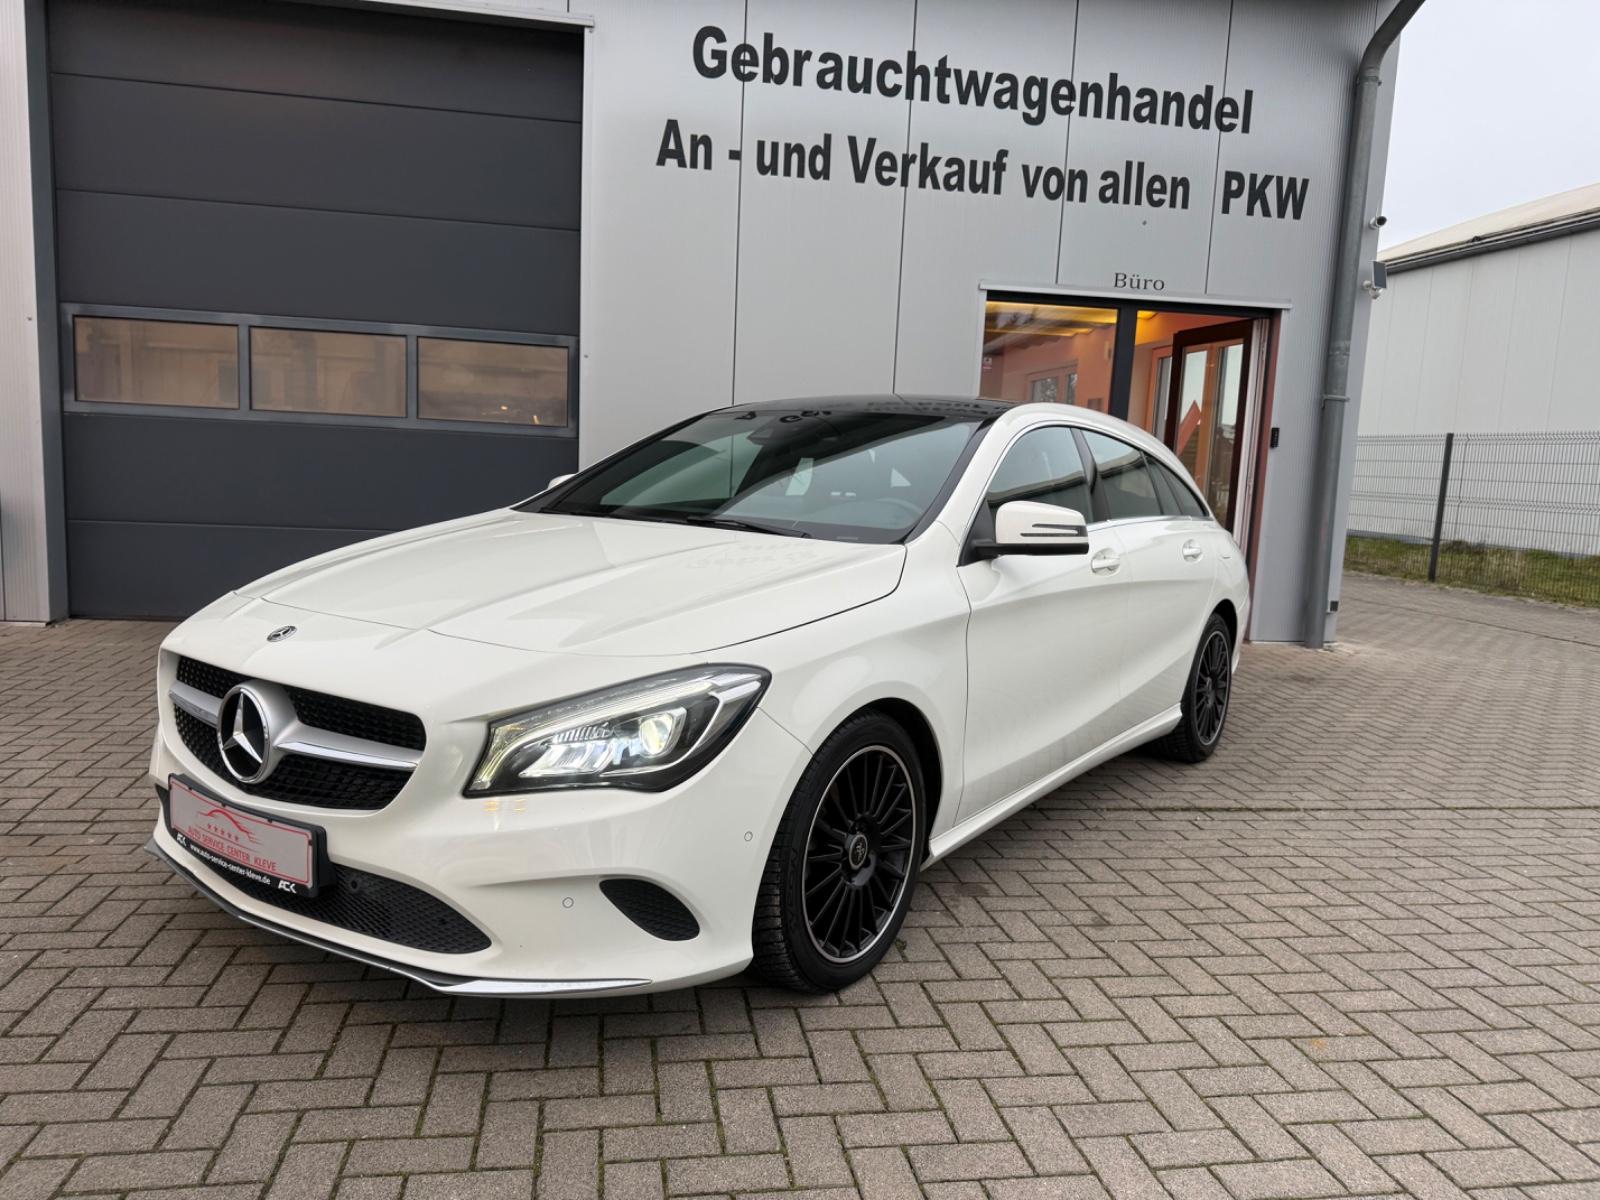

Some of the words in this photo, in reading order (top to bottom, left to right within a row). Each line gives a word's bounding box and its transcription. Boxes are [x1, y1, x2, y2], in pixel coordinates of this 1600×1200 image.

[693, 26, 1253, 133] Gebrauchtwagenhandel
[656, 119, 712, 170] An
[756, 133, 832, 181] und
[847, 136, 1009, 195] Verkauf
[1021, 163, 1088, 203] von
[1098, 160, 1190, 210] allen
[1221, 170, 1310, 221] PKW
[1114, 272, 1165, 291] Büro
[187, 825, 201, 840] AUTO
[202, 834, 225, 852] SERVICE
[226, 845, 250, 864] CENTER
[253, 856, 277, 871] KLEVE
[190, 843, 271, 885] www.auto-service-center-kleve.de
